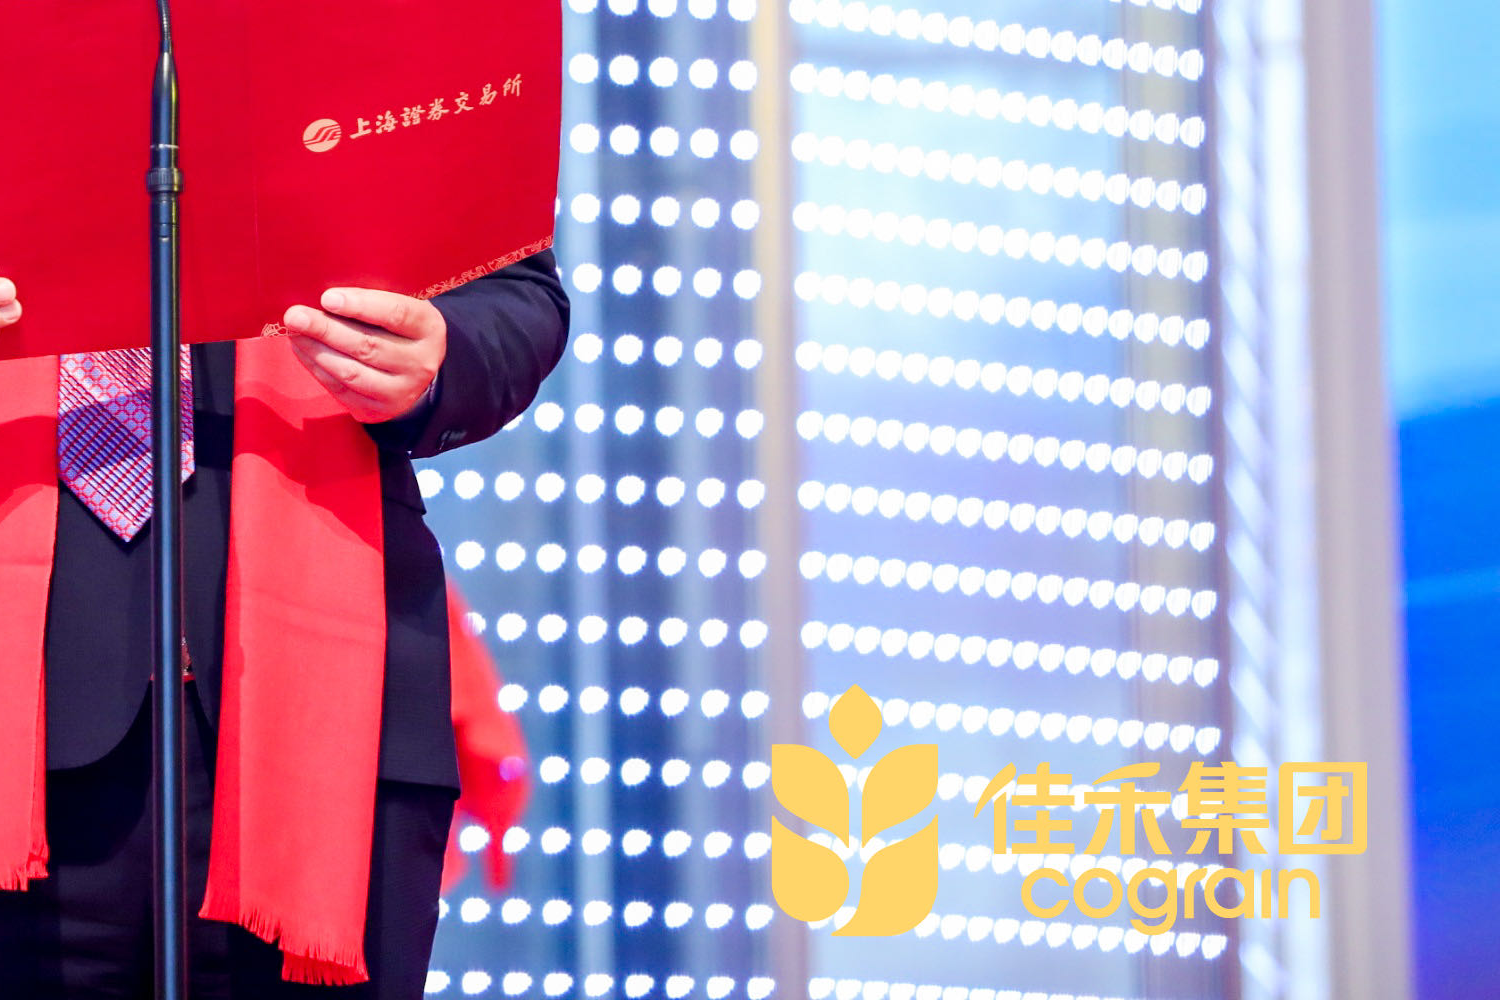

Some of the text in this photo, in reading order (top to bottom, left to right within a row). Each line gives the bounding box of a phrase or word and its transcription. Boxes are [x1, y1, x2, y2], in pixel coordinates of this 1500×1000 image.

[349, 73, 522, 139] 上海證券交易所
